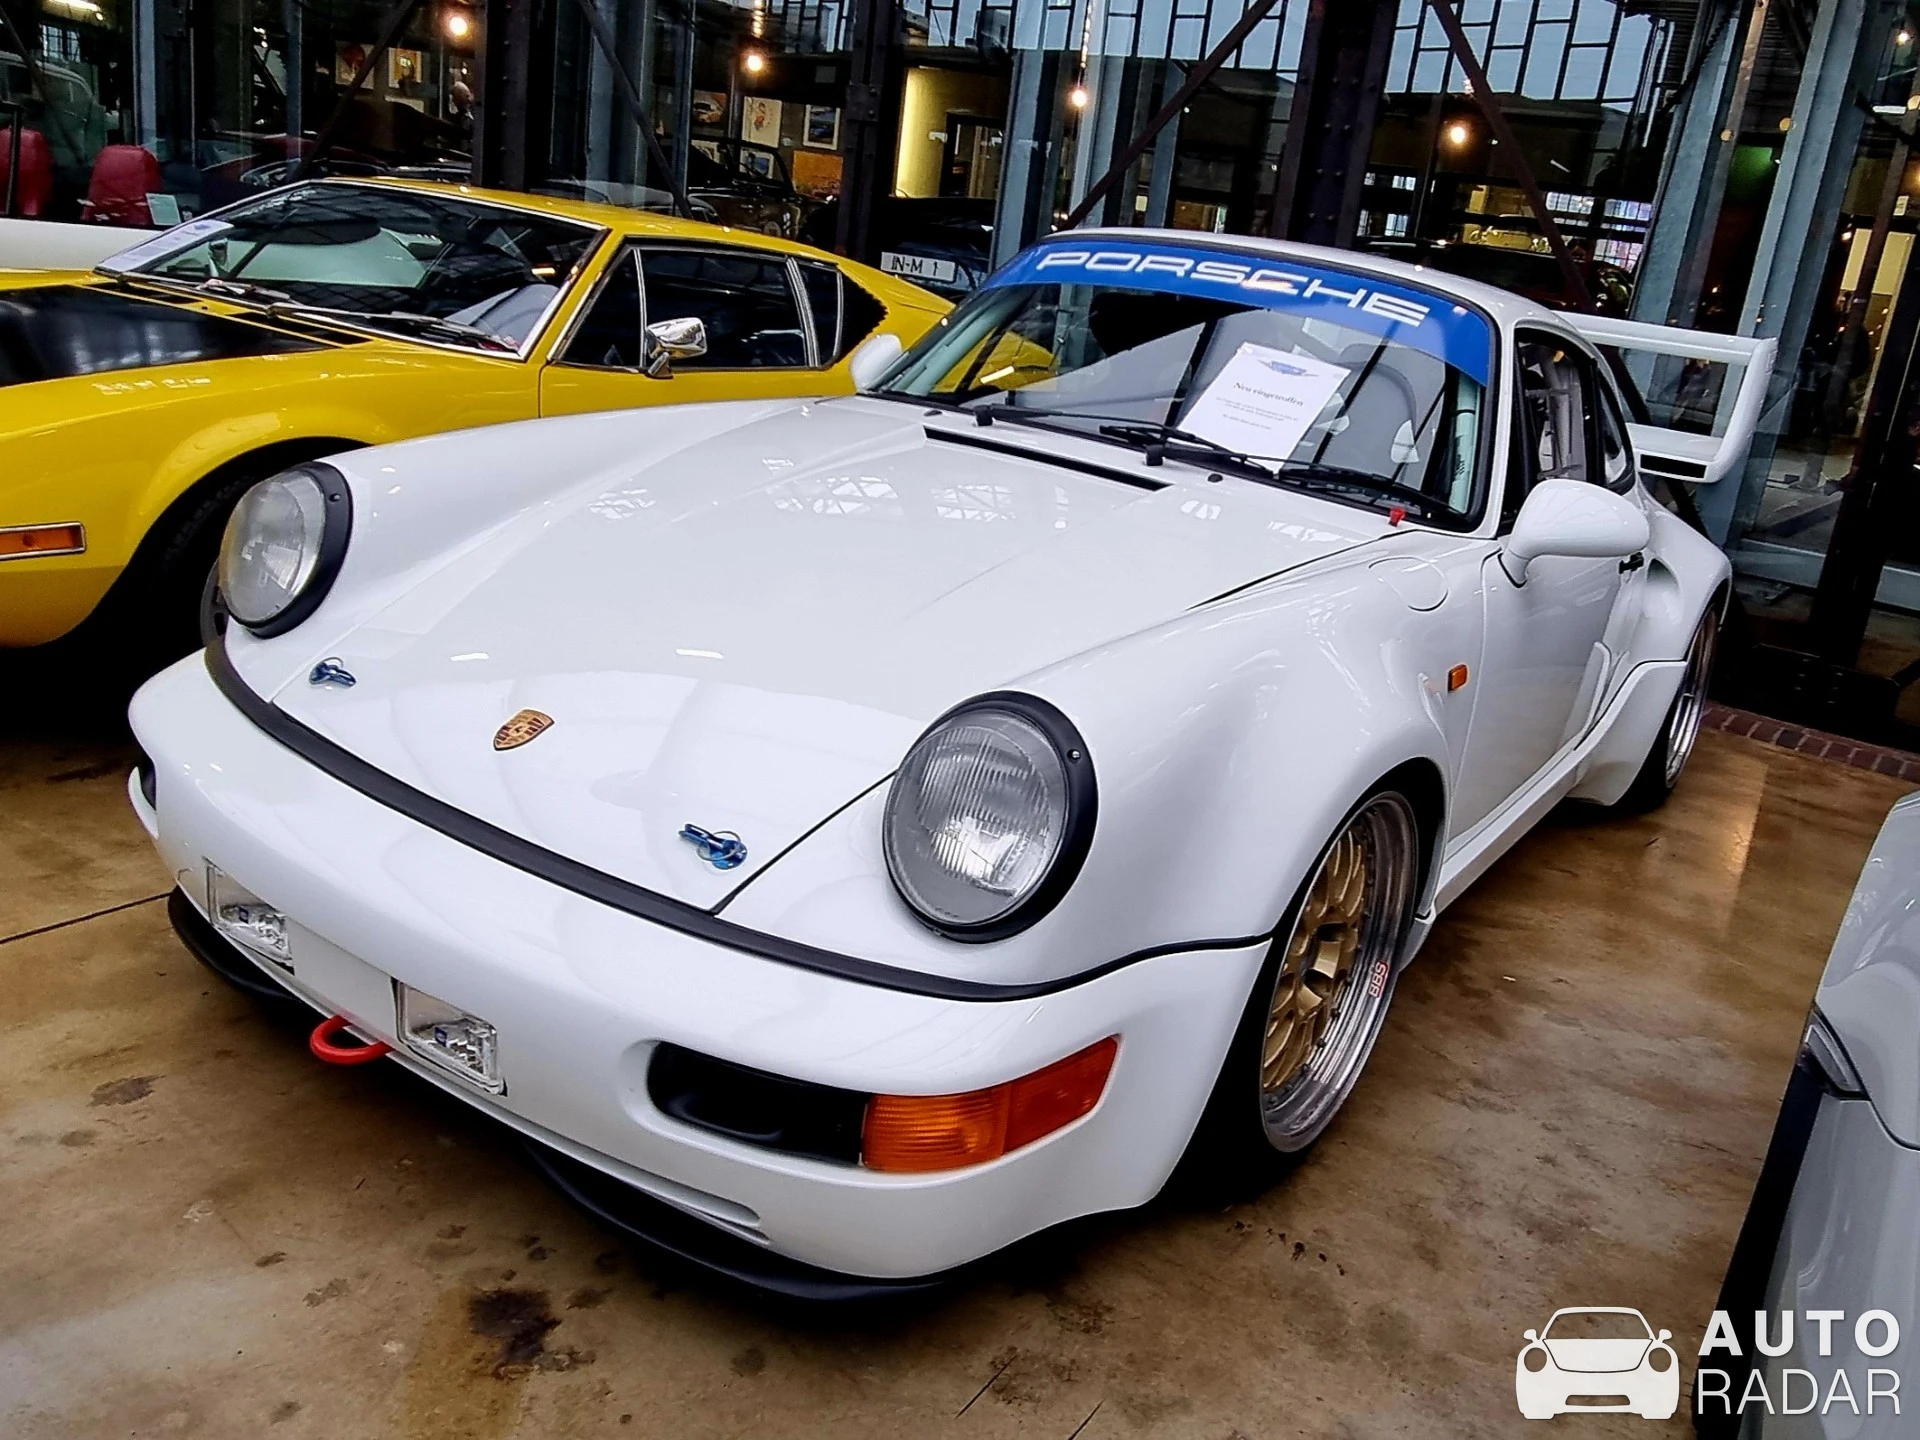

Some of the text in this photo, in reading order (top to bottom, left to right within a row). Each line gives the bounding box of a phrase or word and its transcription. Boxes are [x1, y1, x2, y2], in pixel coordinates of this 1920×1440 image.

[892, 255, 923, 274] IN-M
[1036, 251, 1431, 327] PORSCHE
[1234, 382, 1304, 407] Neu eingetroffen
[1369, 961, 1388, 998] BBS
